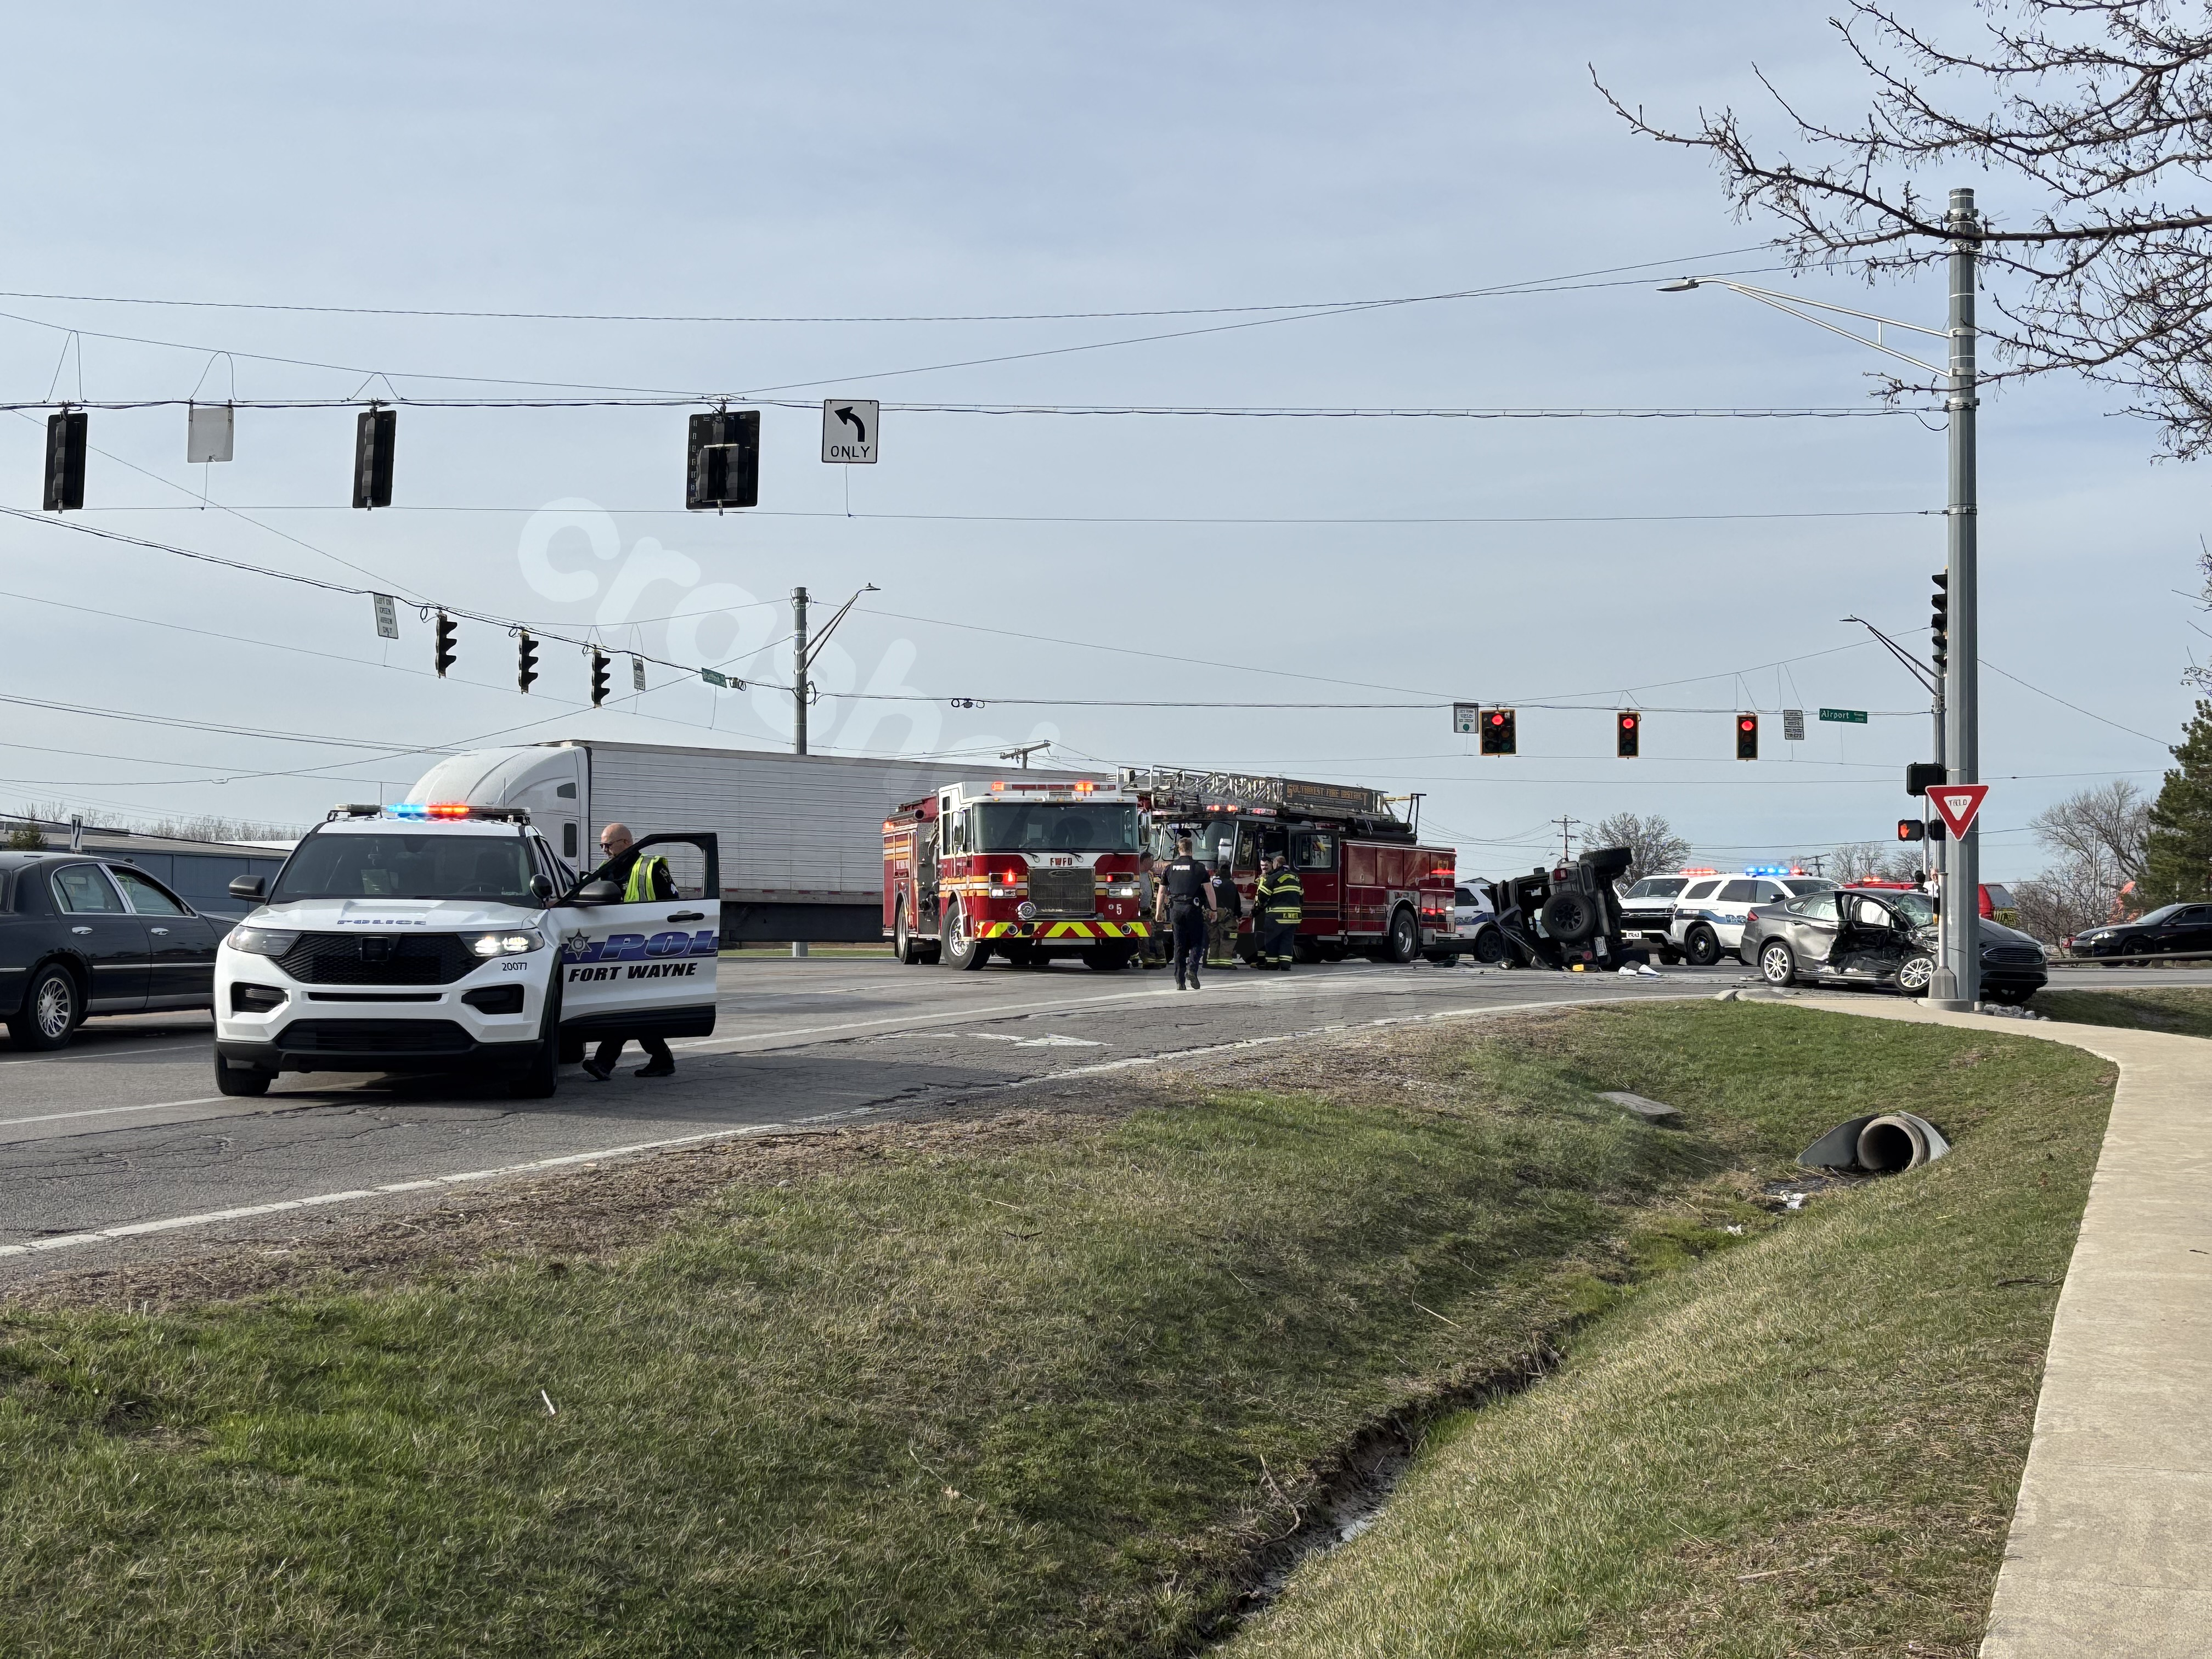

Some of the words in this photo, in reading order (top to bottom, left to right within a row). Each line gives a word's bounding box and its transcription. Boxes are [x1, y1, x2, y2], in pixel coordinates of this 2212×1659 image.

[831, 445, 870, 458] ONLY
[1821, 710, 1849, 719] Airport
[1050, 857, 1073, 866] FWFD
[1116, 904, 1122, 915] 5
[501, 962, 528, 971] 20077
[568, 966, 622, 982] FORT
[628, 962, 698, 979] WAYNE
